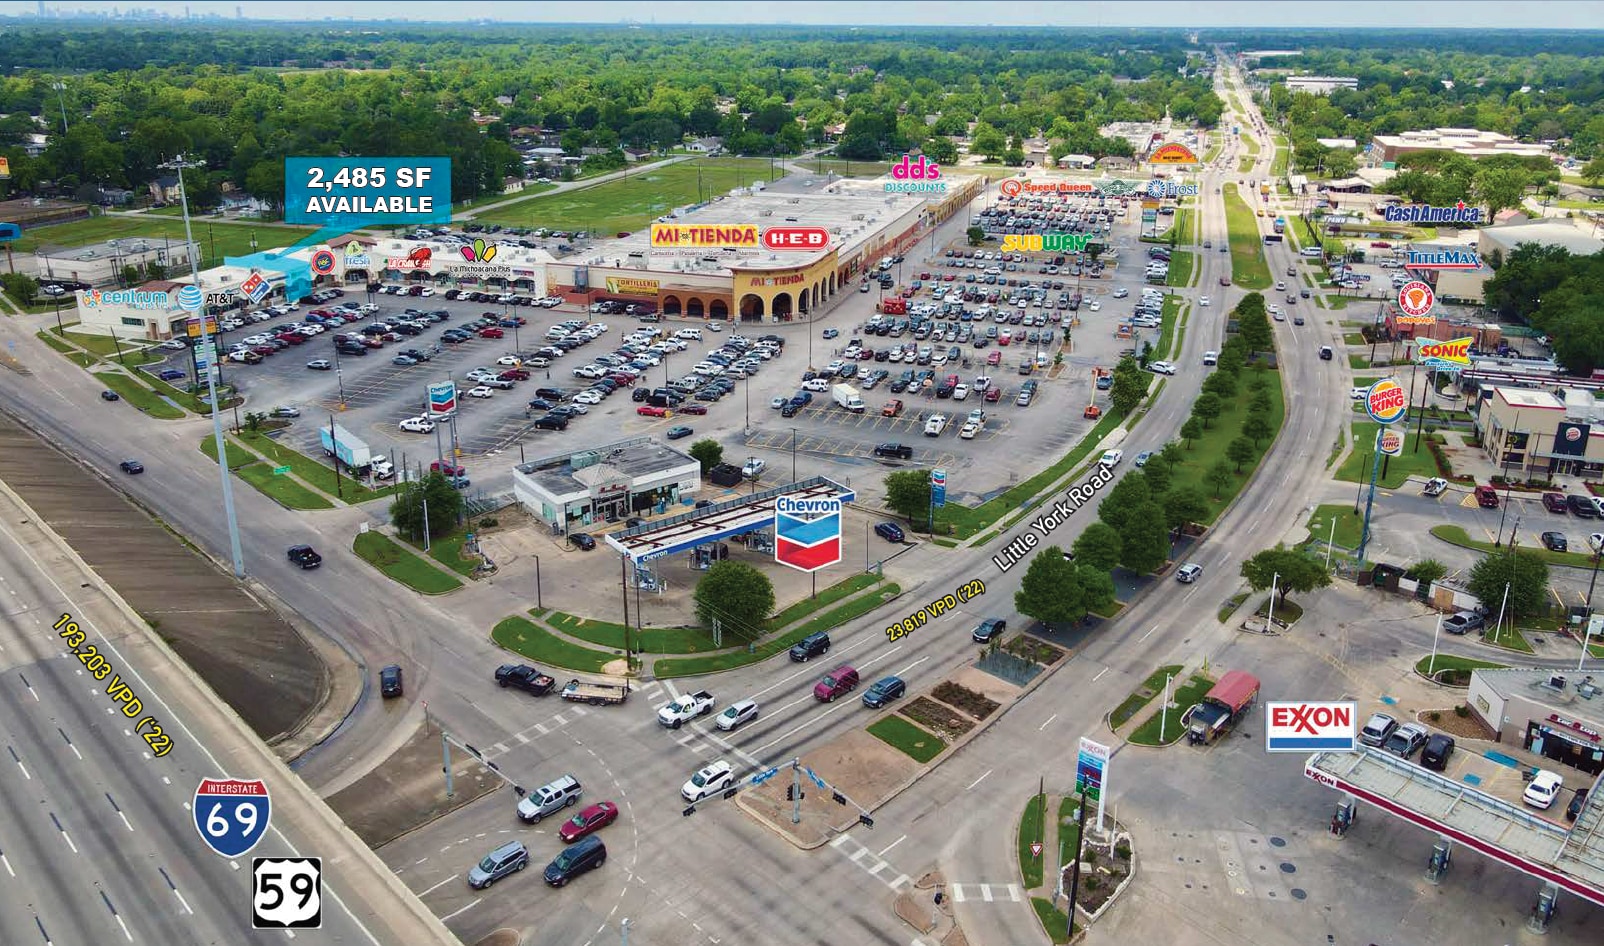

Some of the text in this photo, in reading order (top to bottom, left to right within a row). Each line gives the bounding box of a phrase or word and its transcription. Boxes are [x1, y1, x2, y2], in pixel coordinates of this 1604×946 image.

[774, 274, 805, 286] TIENDA
[642, 549, 668, 562] Chevron
[1306, 769, 1334, 785] EXXON
